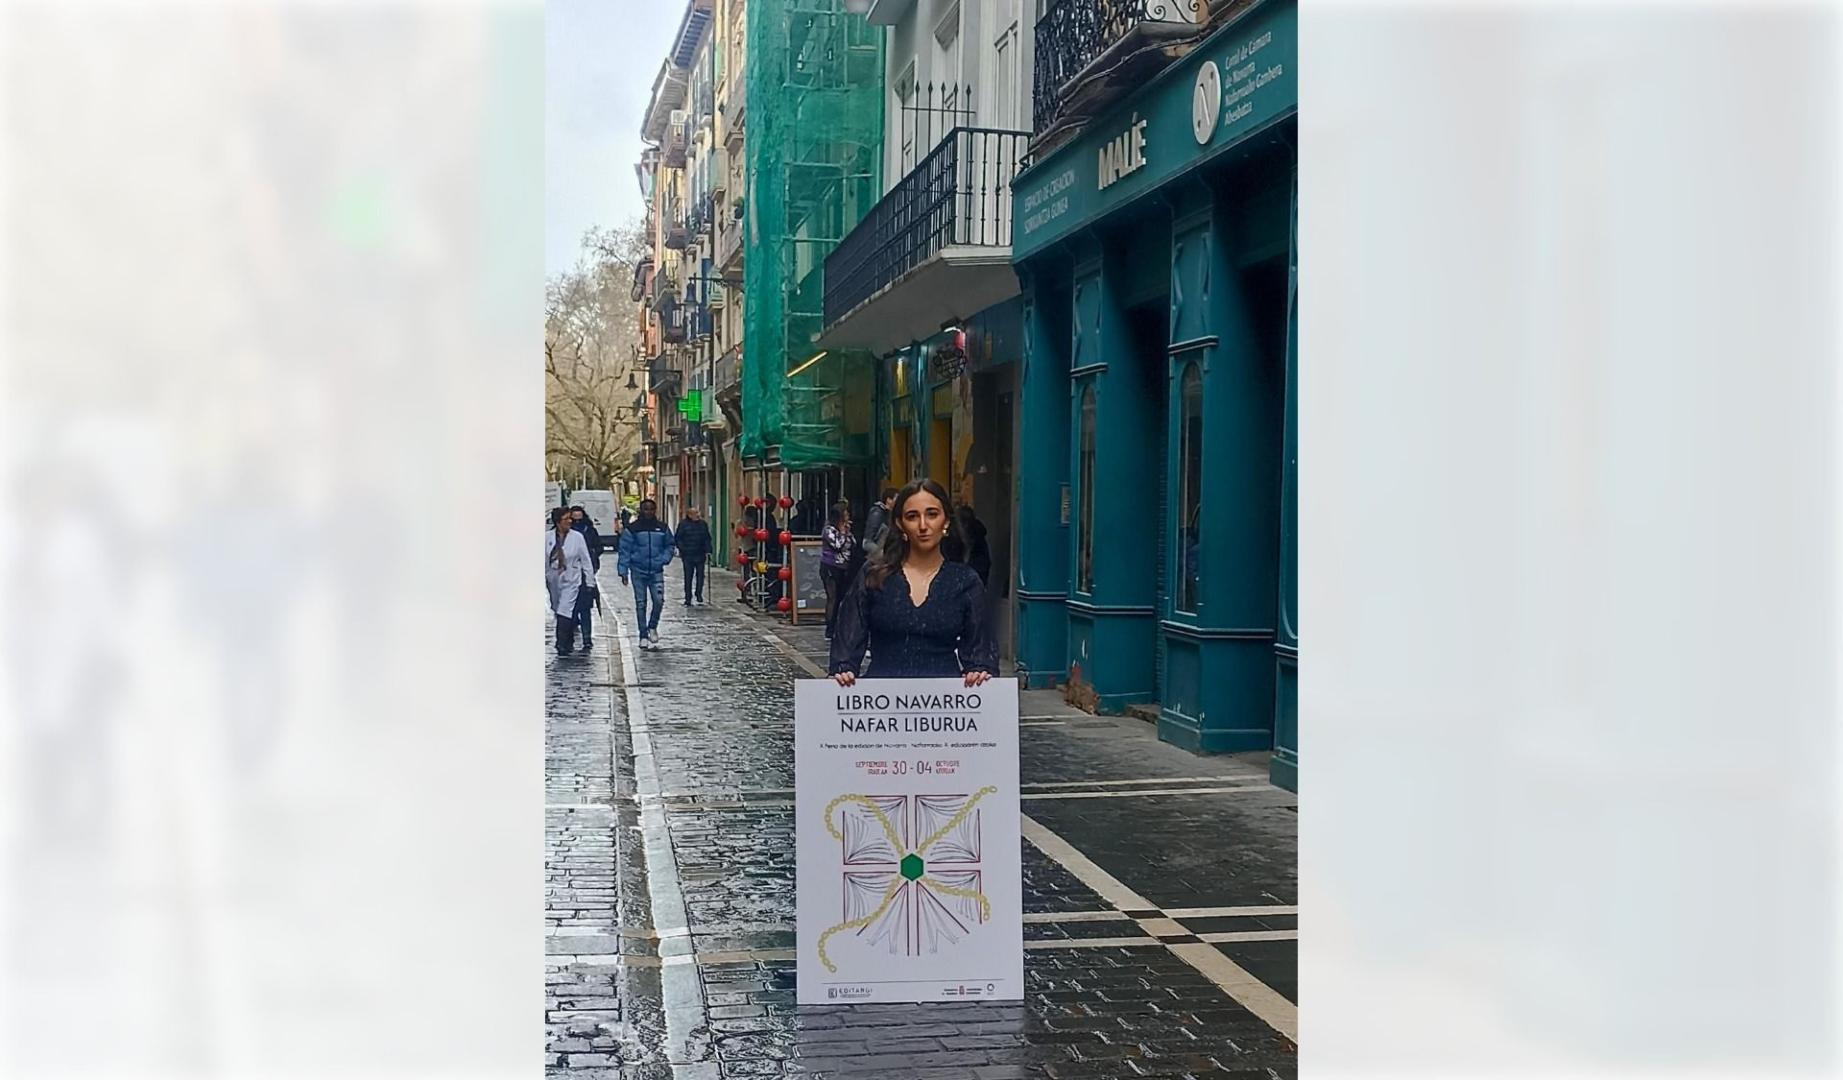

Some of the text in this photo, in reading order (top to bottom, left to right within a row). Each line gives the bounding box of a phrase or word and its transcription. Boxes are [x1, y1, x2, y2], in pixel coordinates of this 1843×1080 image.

[836, 694, 982, 710] LIBRO NAVARRO
[841, 716, 978, 733] NAFAR LIBURUA
[892, 760, 907, 775] 30
[916, 760, 932, 775] 04
